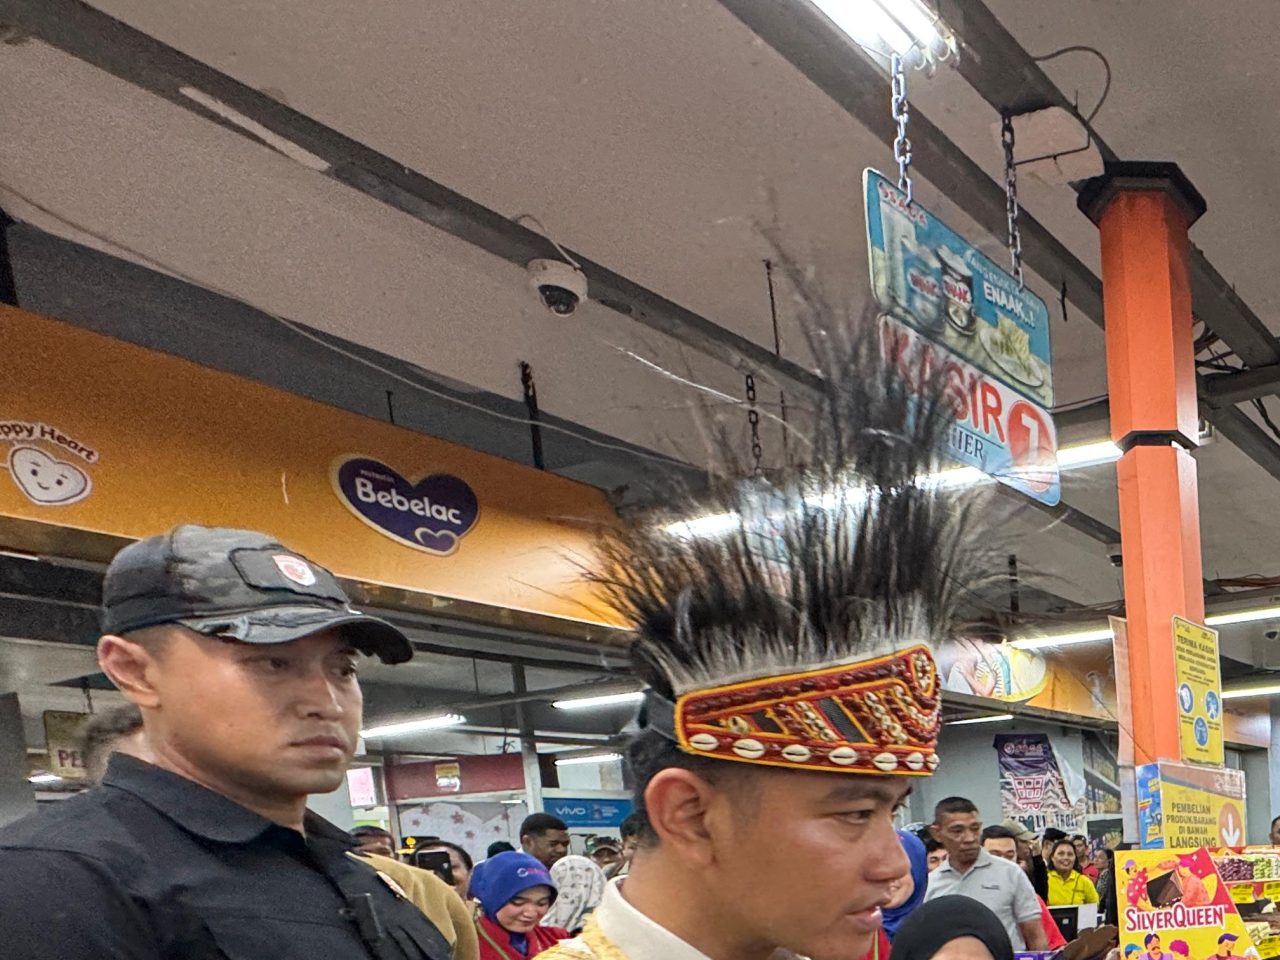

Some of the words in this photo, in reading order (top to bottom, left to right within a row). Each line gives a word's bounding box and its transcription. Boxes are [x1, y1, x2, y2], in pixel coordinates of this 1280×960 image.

[0, 422, 35, 438] ppy
[40, 425, 96, 461] Heart
[354, 476, 462, 526] Bebelac
[555, 806, 586, 816] vivo
[1171, 802, 1211, 815] PEMBELIAN
[1186, 825, 1208, 835] BAWAH
[1169, 835, 1217, 849] LANGSUNG
